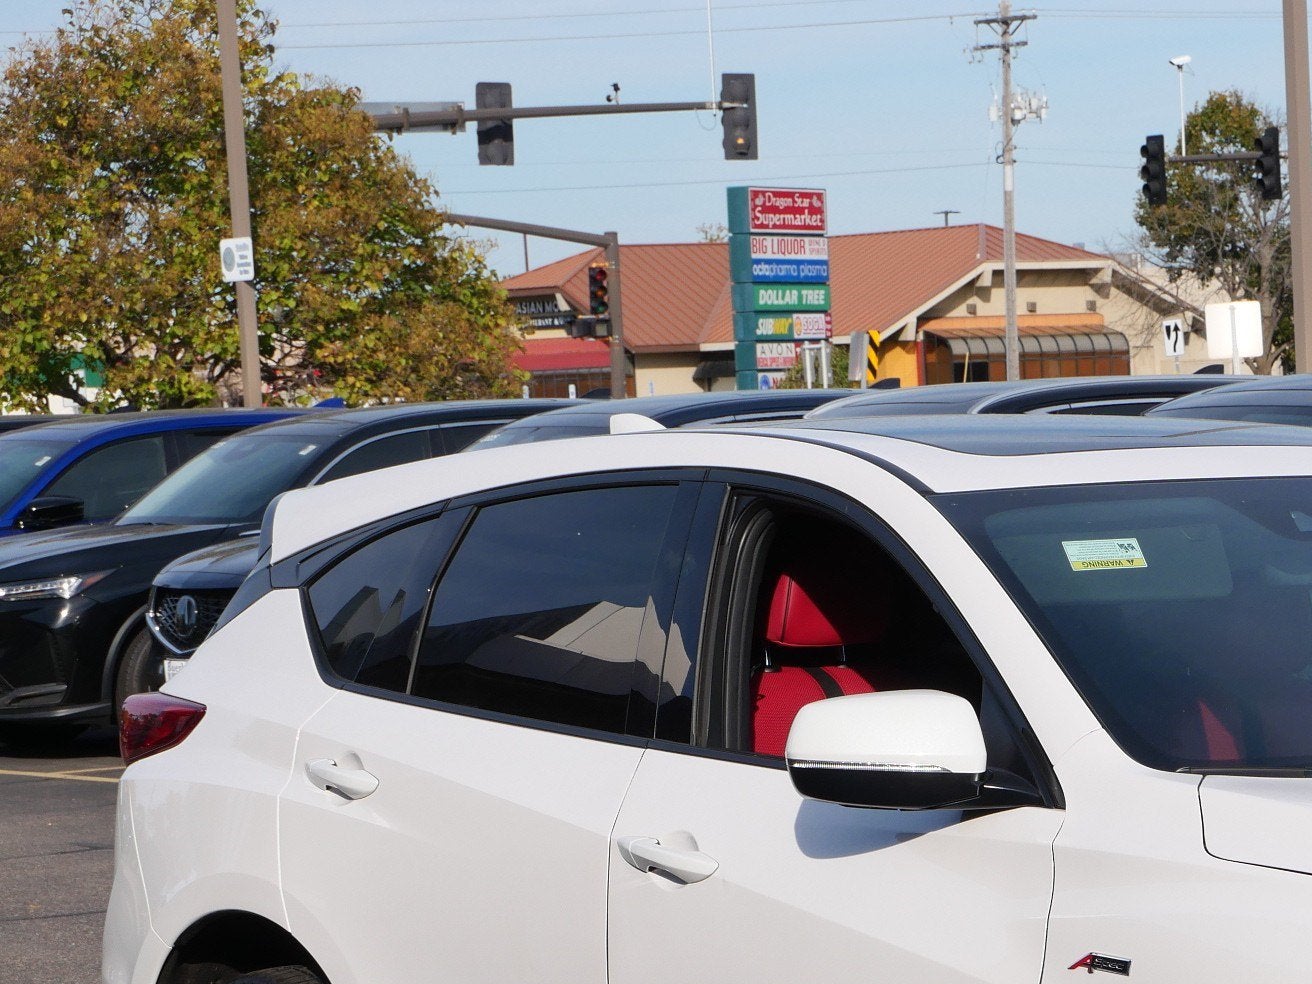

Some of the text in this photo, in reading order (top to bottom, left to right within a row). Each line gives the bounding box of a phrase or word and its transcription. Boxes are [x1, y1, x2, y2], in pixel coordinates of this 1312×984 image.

[765, 192, 811, 209] Dragon Star
[754, 207, 822, 228] Supermarket
[752, 237, 806, 256] BIG LIQUOR
[752, 262, 828, 278] octapharma plasma
[759, 289, 825, 305] DOLLAR TREE
[516, 301, 543, 314] ASIAN
[756, 318, 792, 335] SUBWAY
[759, 342, 793, 356] AVON
[1082, 560, 1124, 568] WARNING
